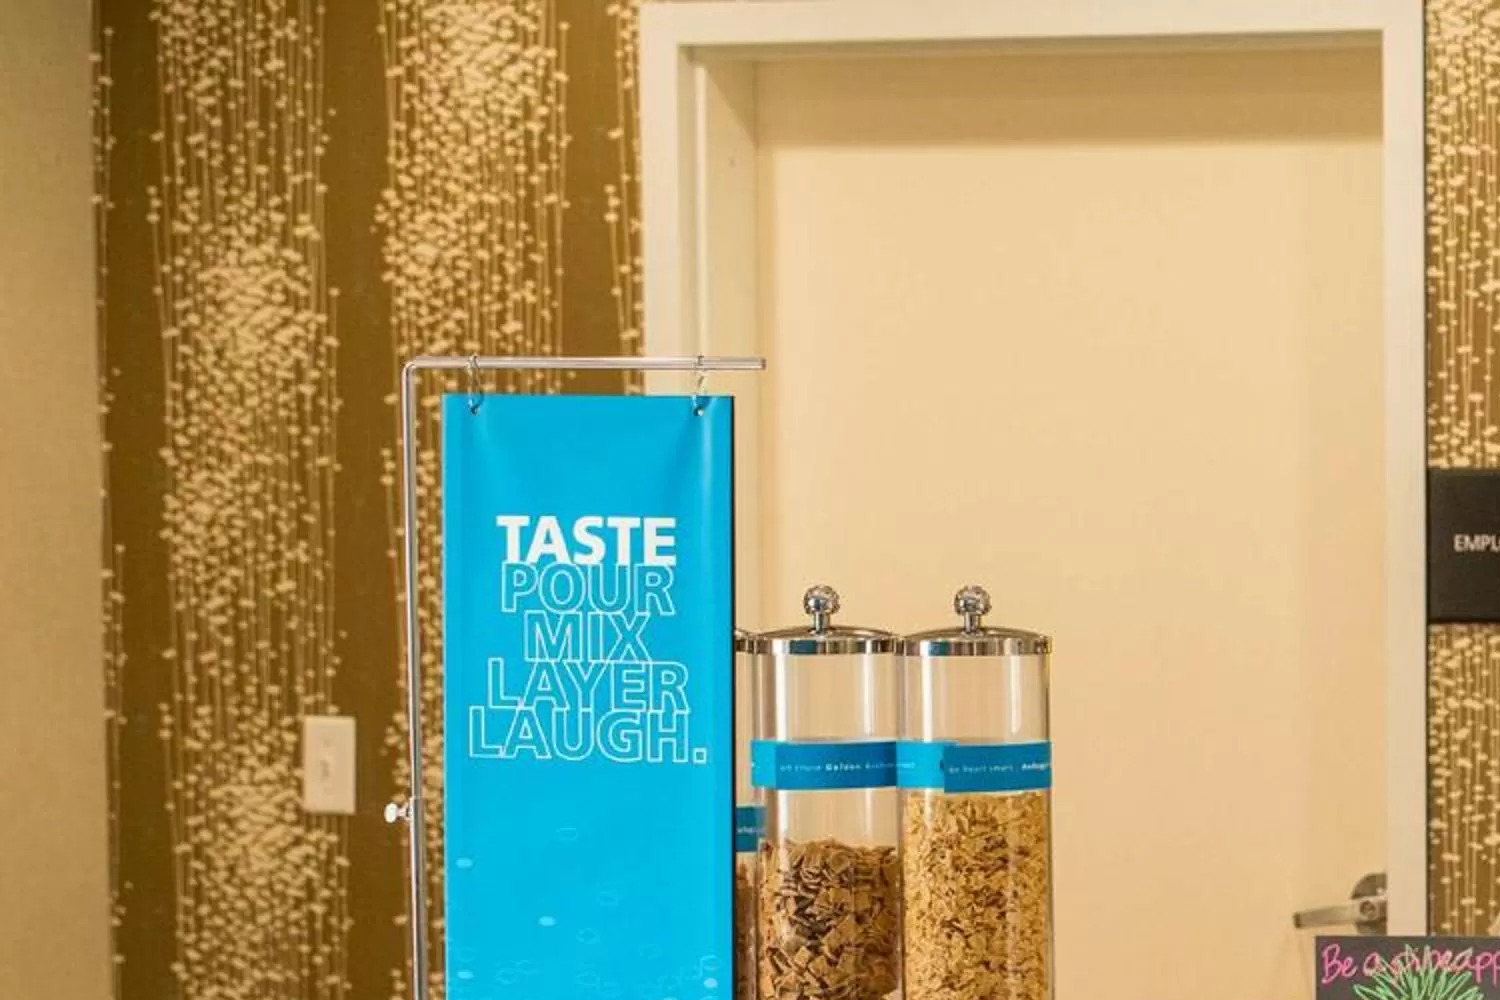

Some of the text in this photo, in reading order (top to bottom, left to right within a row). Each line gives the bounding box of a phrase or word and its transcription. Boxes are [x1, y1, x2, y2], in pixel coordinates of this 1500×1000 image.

[496, 515, 676, 566] TASTE
[501, 561, 676, 616] POUR
[524, 610, 652, 663] MIX
[487, 657, 691, 715] LAYER
[468, 706, 707, 764] LAUGH.
[1321, 943, 1358, 985] Be
[1363, 951, 1386, 977] a
